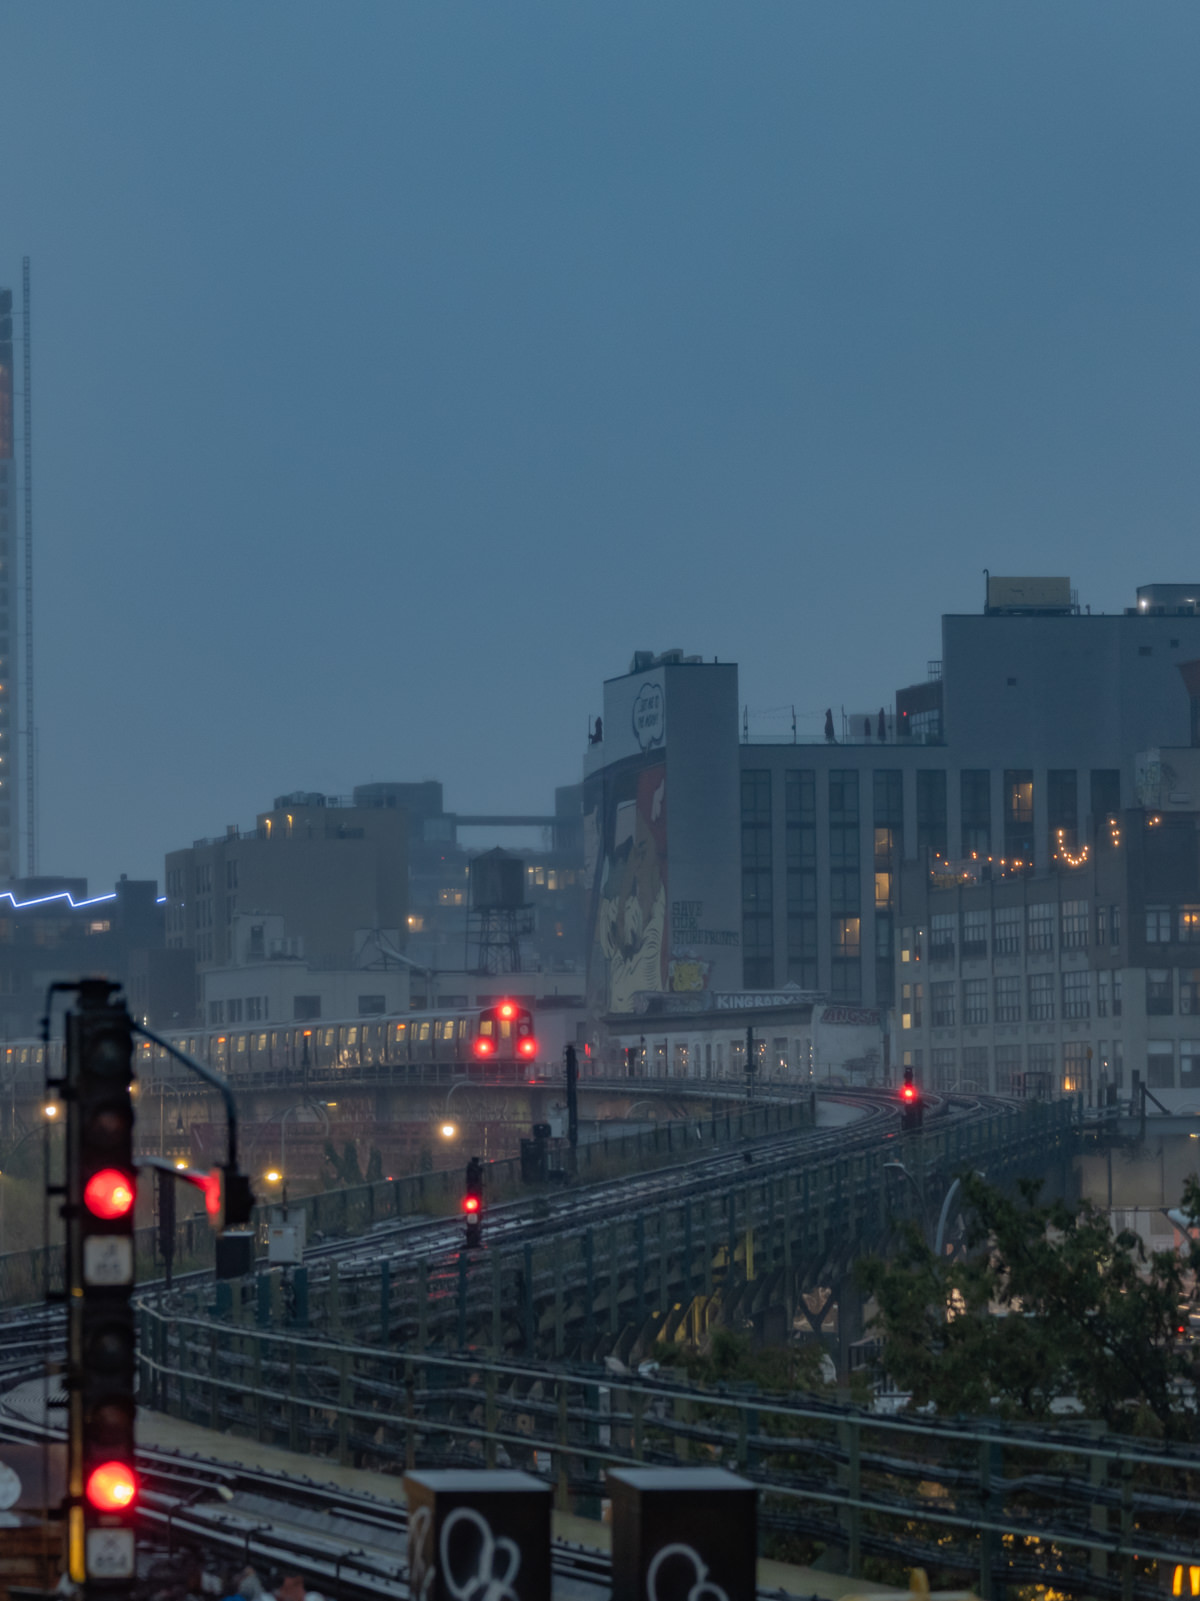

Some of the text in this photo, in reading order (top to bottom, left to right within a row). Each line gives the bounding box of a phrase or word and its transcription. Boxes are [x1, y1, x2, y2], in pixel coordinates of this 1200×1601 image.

[672, 901, 705, 916] SAVE
[672, 916, 697, 929] OUR
[672, 929, 741, 947] STOREFRONTS
